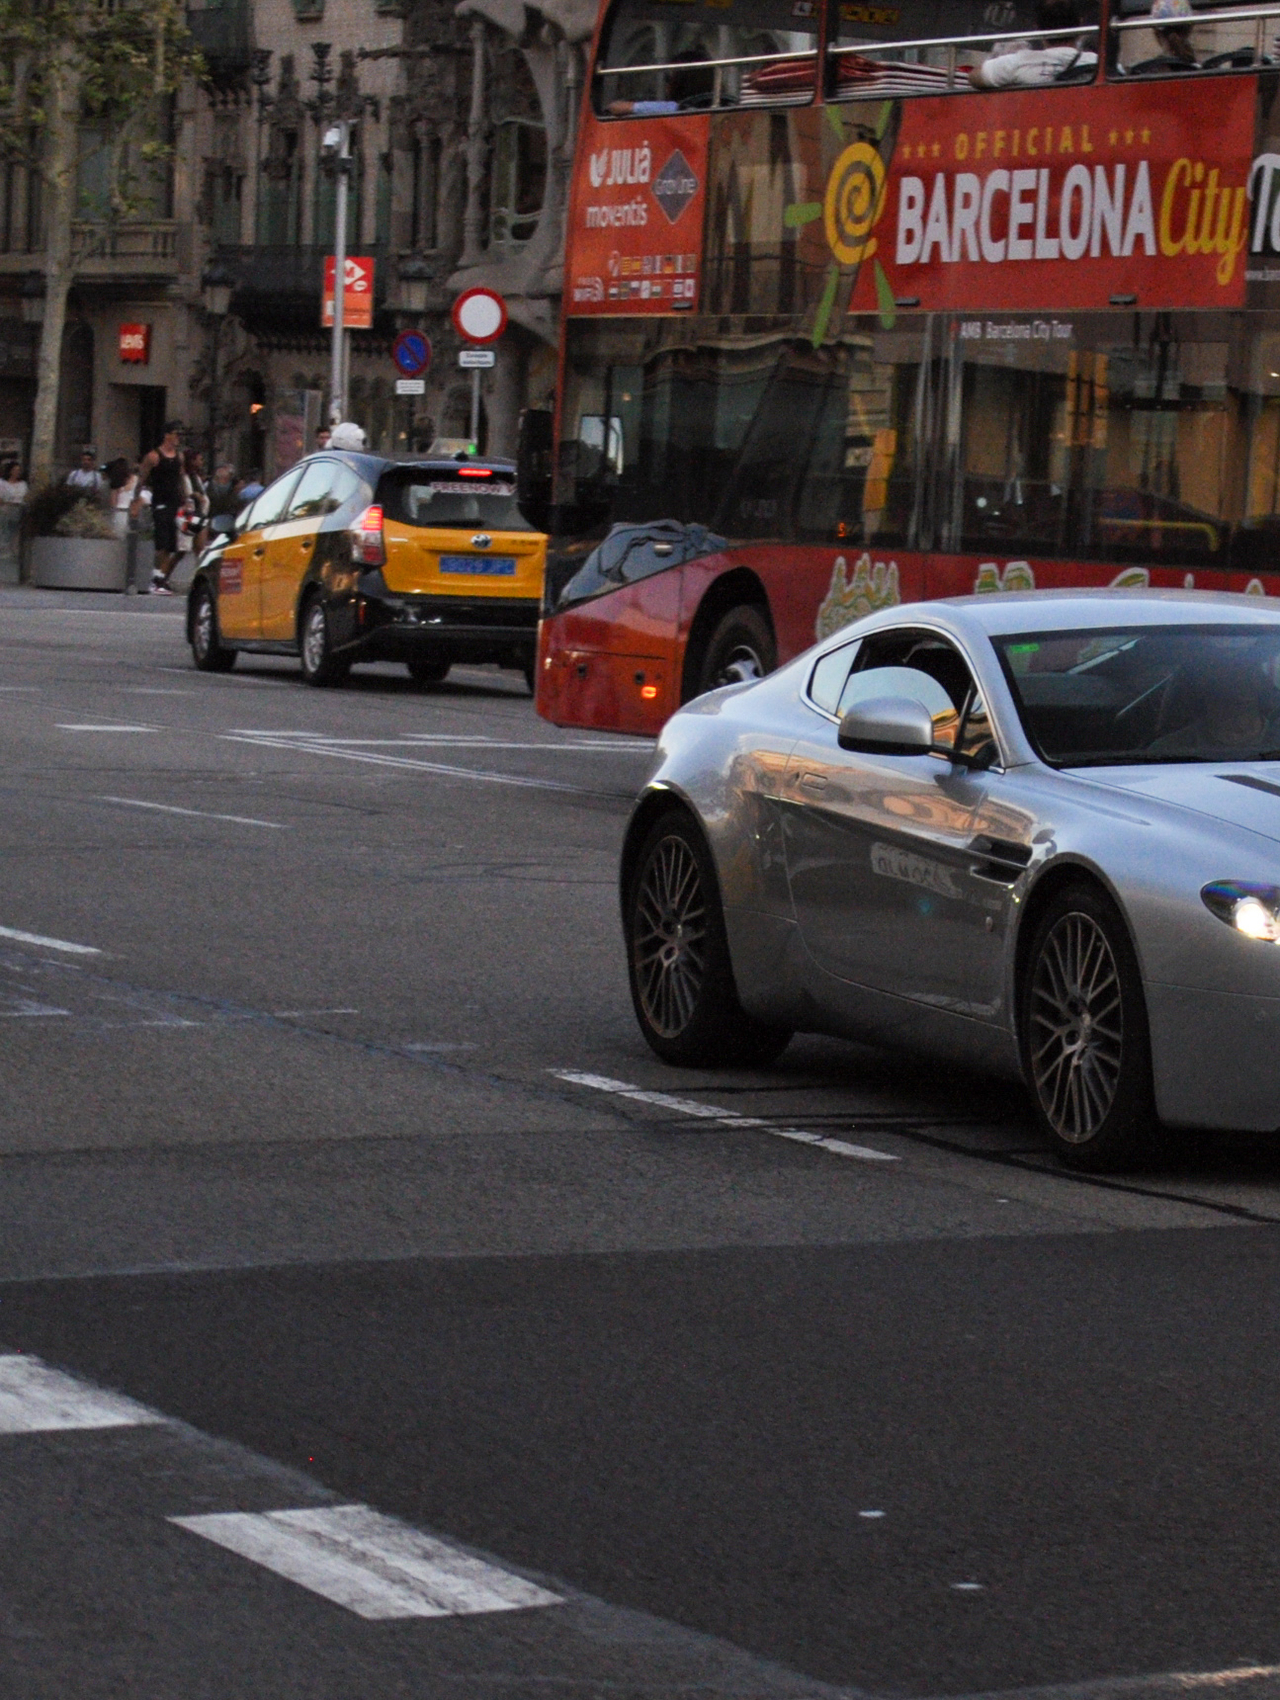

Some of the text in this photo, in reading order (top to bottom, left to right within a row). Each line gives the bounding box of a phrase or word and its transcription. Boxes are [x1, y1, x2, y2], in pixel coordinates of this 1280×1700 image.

[954, 125, 1094, 160] OFFICIAL
[586, 195, 648, 228] moventis
[895, 160, 1157, 265] BARCELONA
[1159, 157, 1249, 287] City
[986, 320, 1030, 338] Barcelona
[1032, 320, 1050, 341] City
[1052, 320, 1074, 338] Tour
